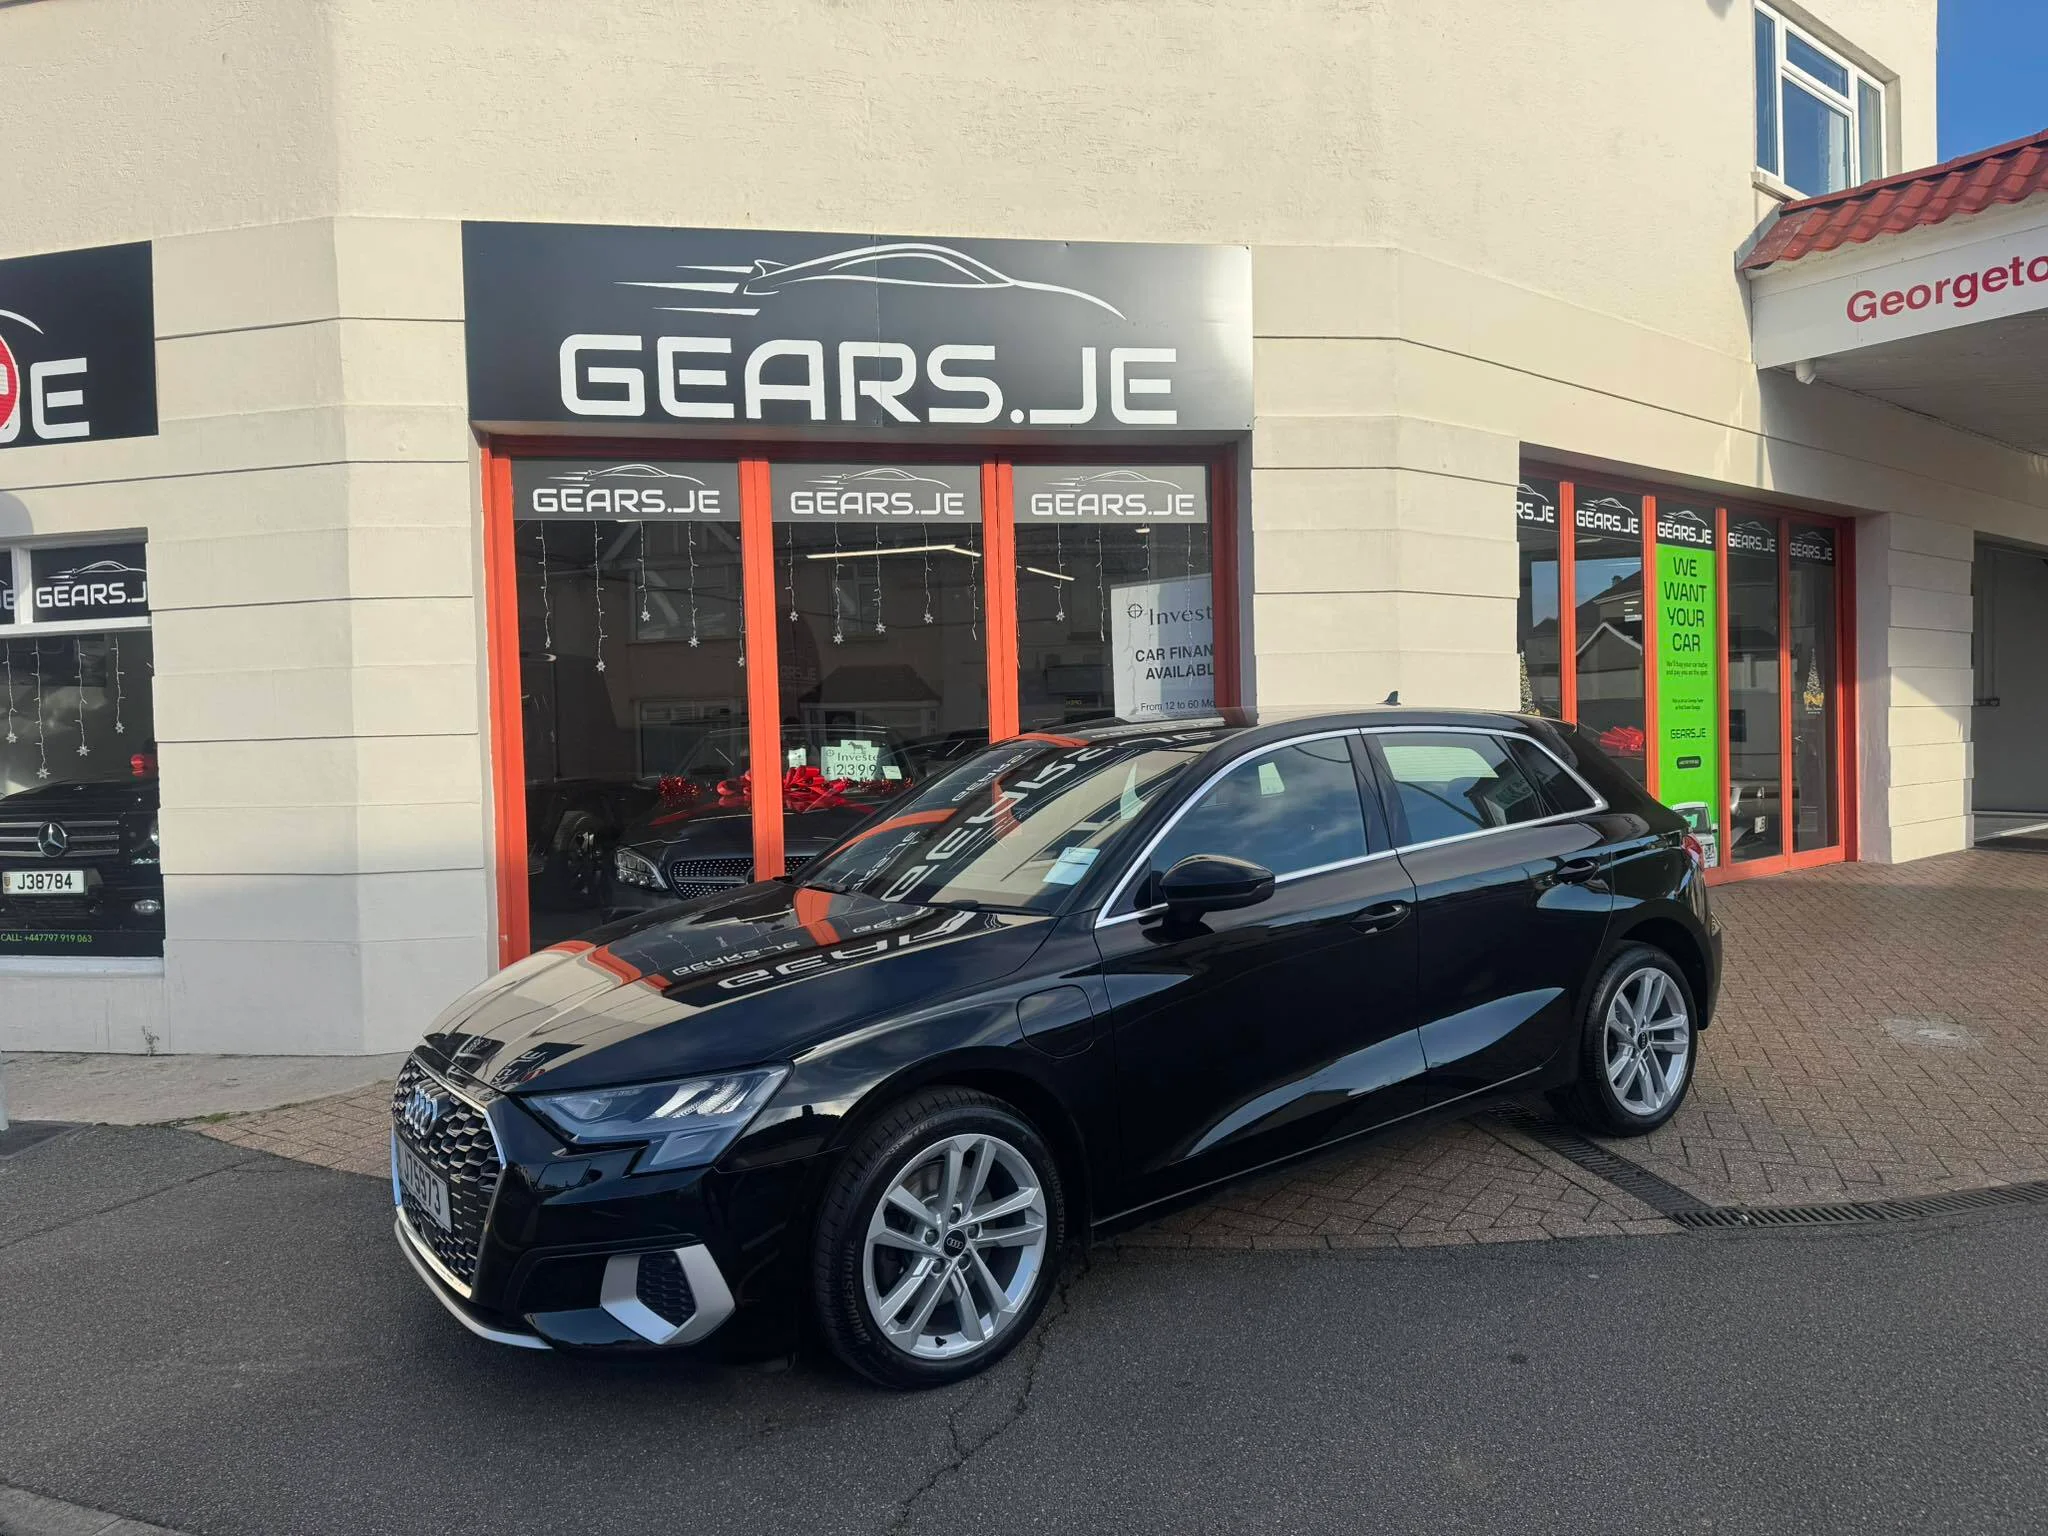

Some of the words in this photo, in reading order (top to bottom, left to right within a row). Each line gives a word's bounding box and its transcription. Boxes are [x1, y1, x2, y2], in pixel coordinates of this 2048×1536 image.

[559, 333, 1177, 424] GEARS.JE
[532, 488, 720, 514] GEARS.JE
[790, 491, 965, 515] GEARS.JE
[1031, 493, 1195, 516] GEARS.JE
[1576, 509, 1639, 534] GEARS.JE
[1657, 521, 1712, 544] GEARS.JE
[1728, 532, 1776, 552] GEARS.JE
[1673, 557, 1697, 577] WE
[1664, 581, 1707, 602] WANT
[1667, 607, 1704, 627] YOUR
[1672, 633, 1701, 652] CAR
[1135, 649, 1165, 662] CAR
[1140, 702, 1162, 711] From
[1165, 702, 1175, 710] 12
[1177, 701, 1185, 709] to
[1188, 700, 1198, 709] 60
[17, 872, 73, 891] J38784
[24, 933, 58, 942] +447797
[60, 934, 75, 942] 919
[77, 935, 93, 943] 063
